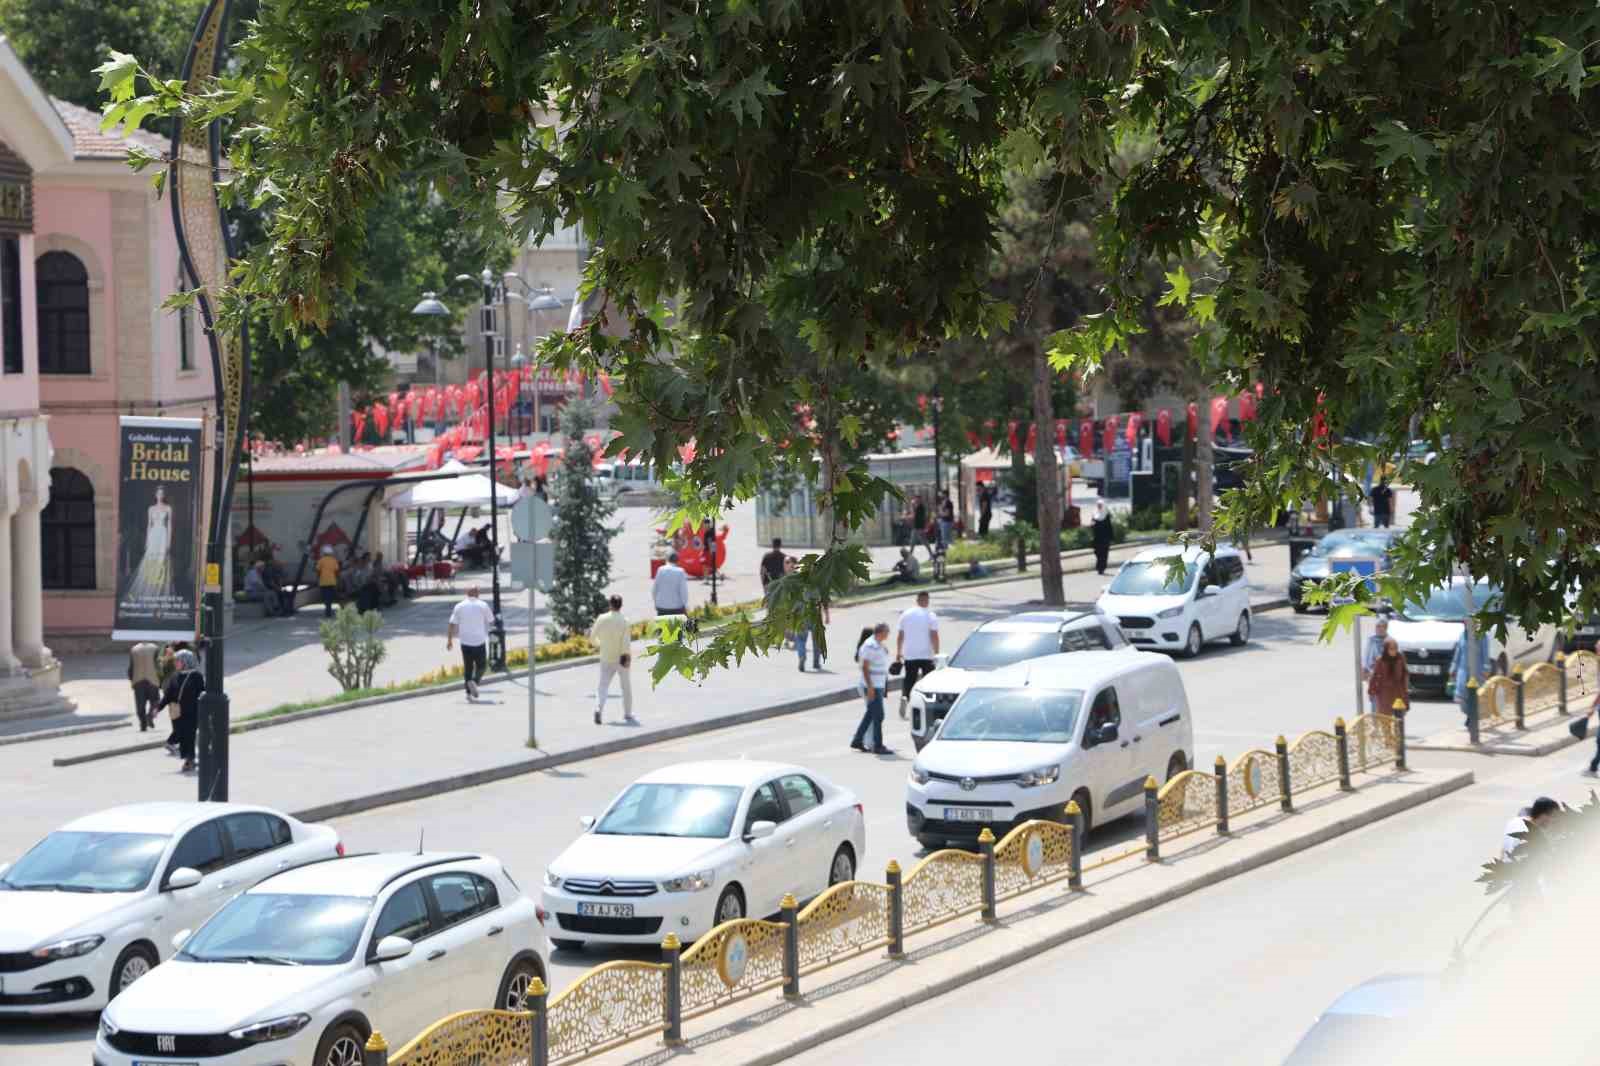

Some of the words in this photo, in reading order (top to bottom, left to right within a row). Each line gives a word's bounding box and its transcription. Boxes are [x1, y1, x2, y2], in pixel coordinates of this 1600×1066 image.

[132, 442, 189, 462] Bridal
[130, 462, 191, 482] House
[598, 904, 610, 915] AJ
[156, 1034, 176, 1053] FIAT
